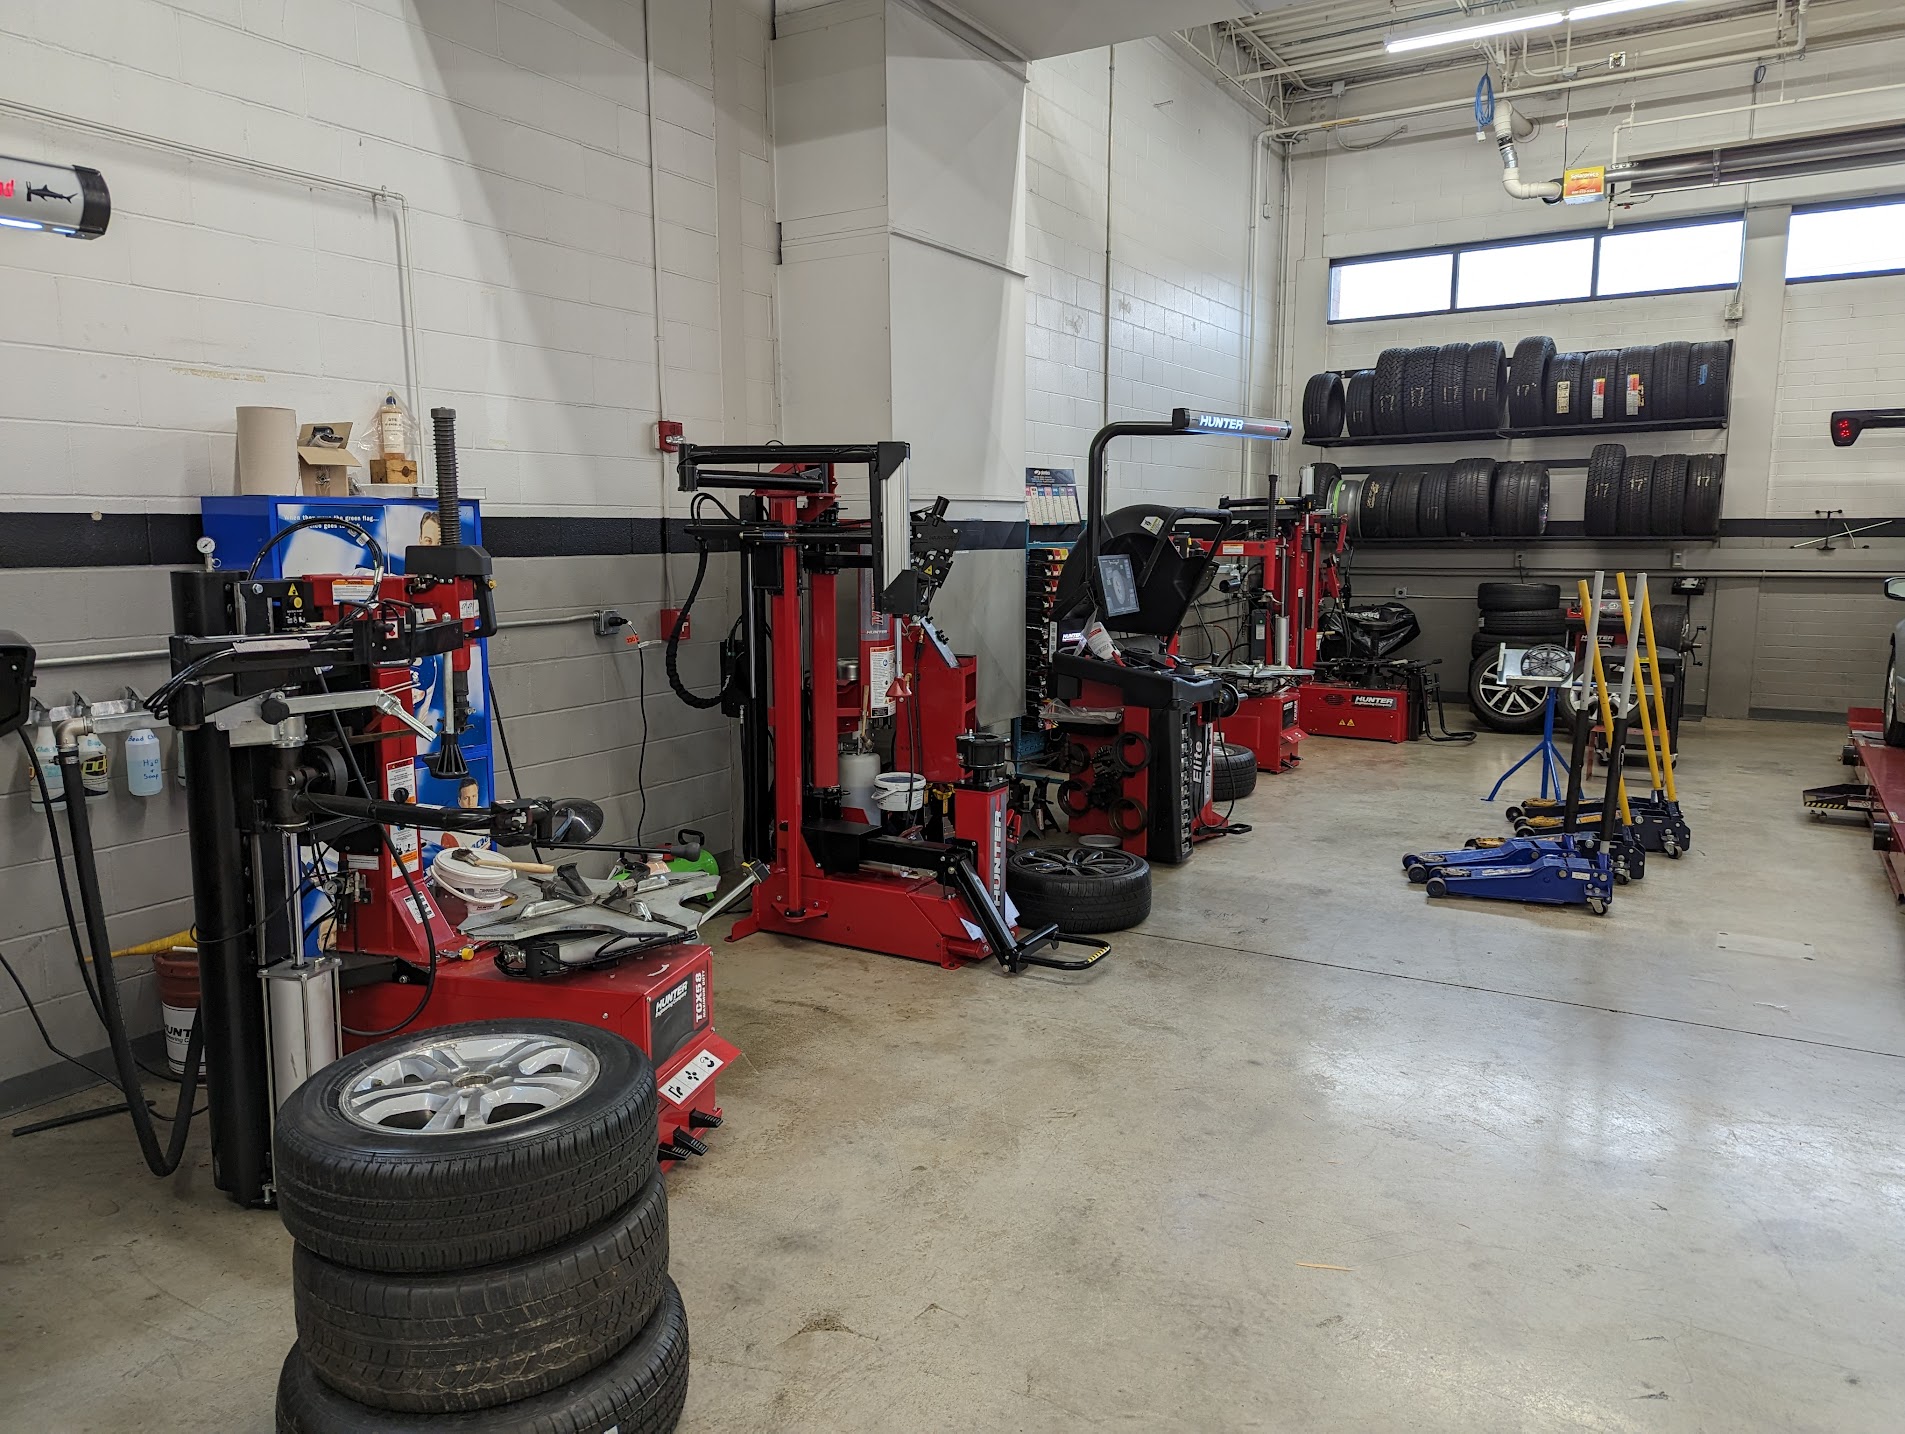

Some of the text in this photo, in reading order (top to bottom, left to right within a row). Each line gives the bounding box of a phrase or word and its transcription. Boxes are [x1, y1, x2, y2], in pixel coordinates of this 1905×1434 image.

[1199, 415, 1244, 430] HUNTER
[1697, 475, 1710, 487] 17
[1355, 696, 1394, 704] HUNTER
[1193, 740, 1203, 784] Elite
[993, 810, 1002, 907] HUNTER
[655, 981, 688, 1013] HUNTER
[695, 972, 703, 1023] TCX58
[164, 1024, 192, 1038] UNT
